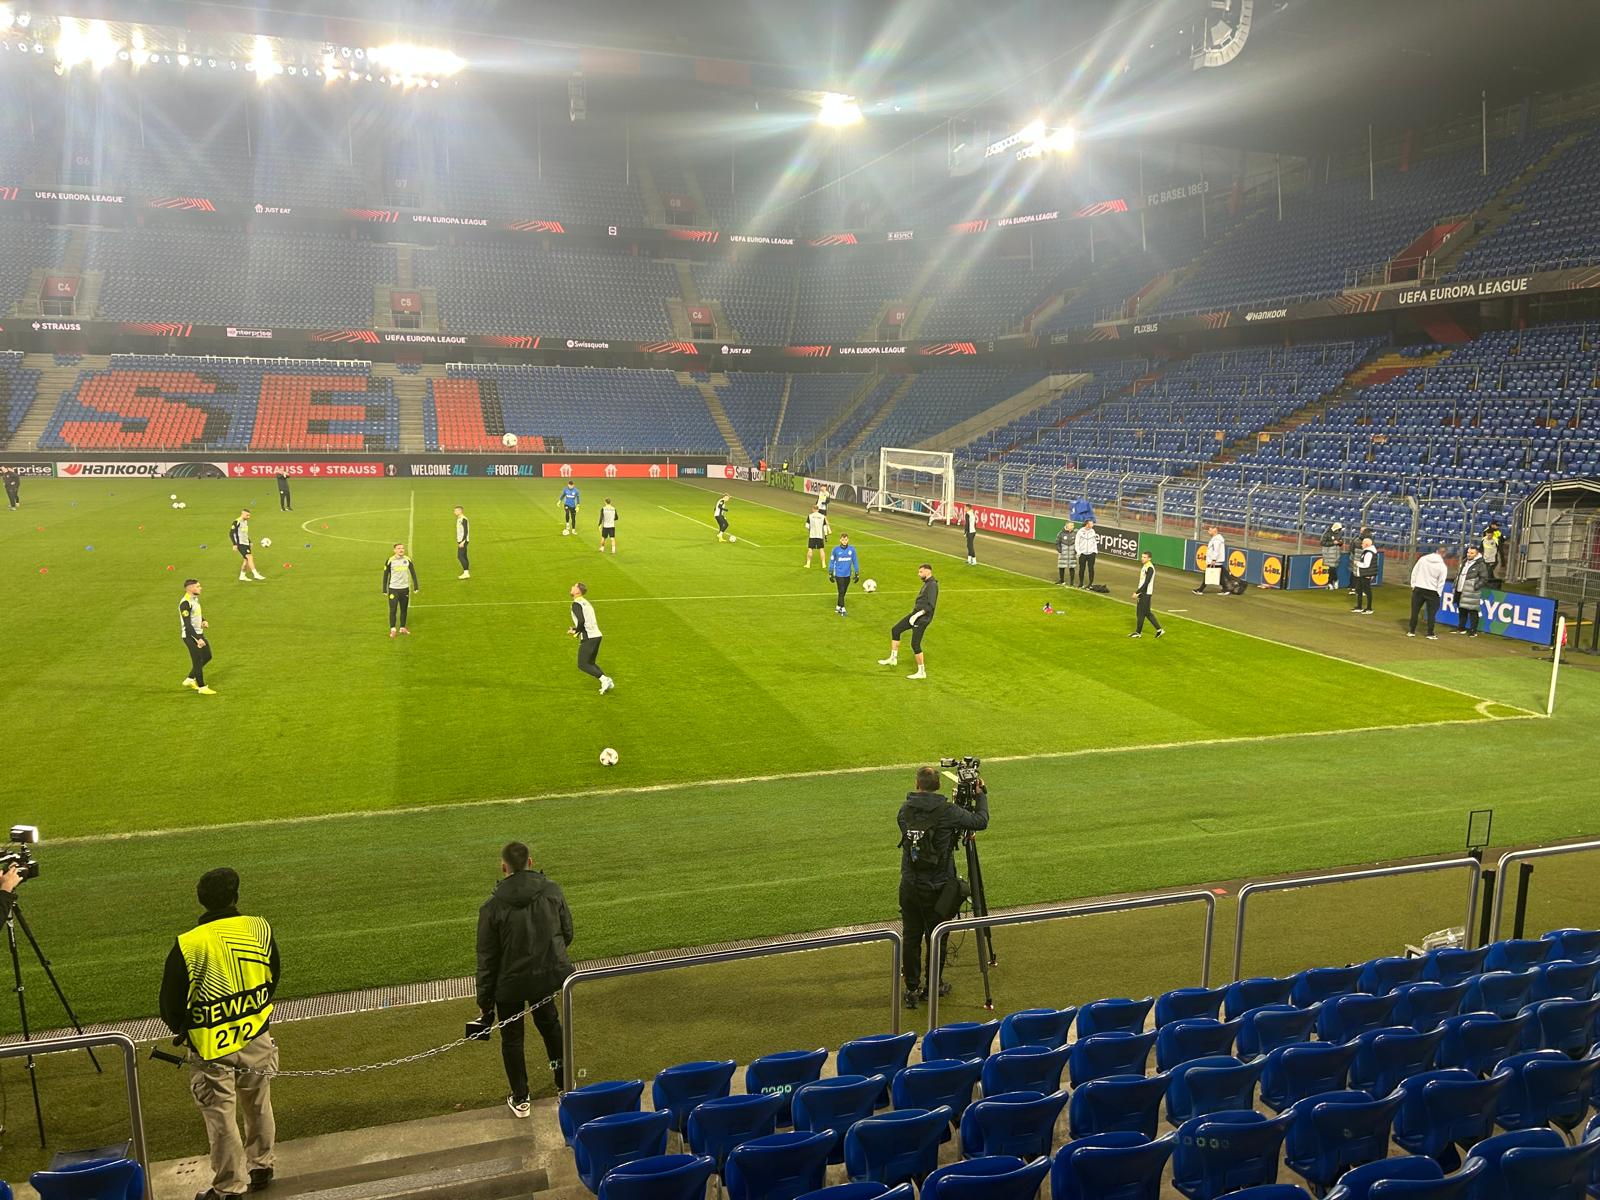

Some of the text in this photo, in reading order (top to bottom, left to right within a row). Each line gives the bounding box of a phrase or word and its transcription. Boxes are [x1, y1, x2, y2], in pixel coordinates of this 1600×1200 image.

[58, 193, 91, 201] EUROPA
[91, 194, 123, 203] LEAGUE
[1160, 186, 1186, 202] BASEL
[412, 215, 487, 226] UEFA EUROPA LEAGUE
[998, 212, 1058, 226] UEFA EUROPA LEAGUE
[746, 236, 770, 244] EUROPA
[770, 237, 794, 245] LEAGUE
[57, 283, 71, 291] C4
[1399, 278, 1528, 304] UEFA EUROPA LEAGUE
[401, 298, 412, 306] C5
[41, 322, 81, 331] STRAUSS
[1133, 323, 1158, 335] FLIXBUS
[385, 334, 466, 344] UEFA EUROPA LEAGUE
[574, 340, 609, 349] Swissquote
[839, 347, 856, 355] UEFA
[881, 346, 905, 354] LEAGUE
[326, 465, 377, 474] STRAUSS
[410, 465, 469, 476] WELCOME ALL
[486, 465, 534, 476] #FOOTBALL
[989, 514, 1031, 534] STRAUSS
[1110, 548, 1136, 558] rent-a-car
[1313, 566, 1329, 576] LiD
[1442, 592, 1542, 630] RYCLE
[192, 987, 269, 1024] STEWARD
[215, 1021, 254, 1050] 272
